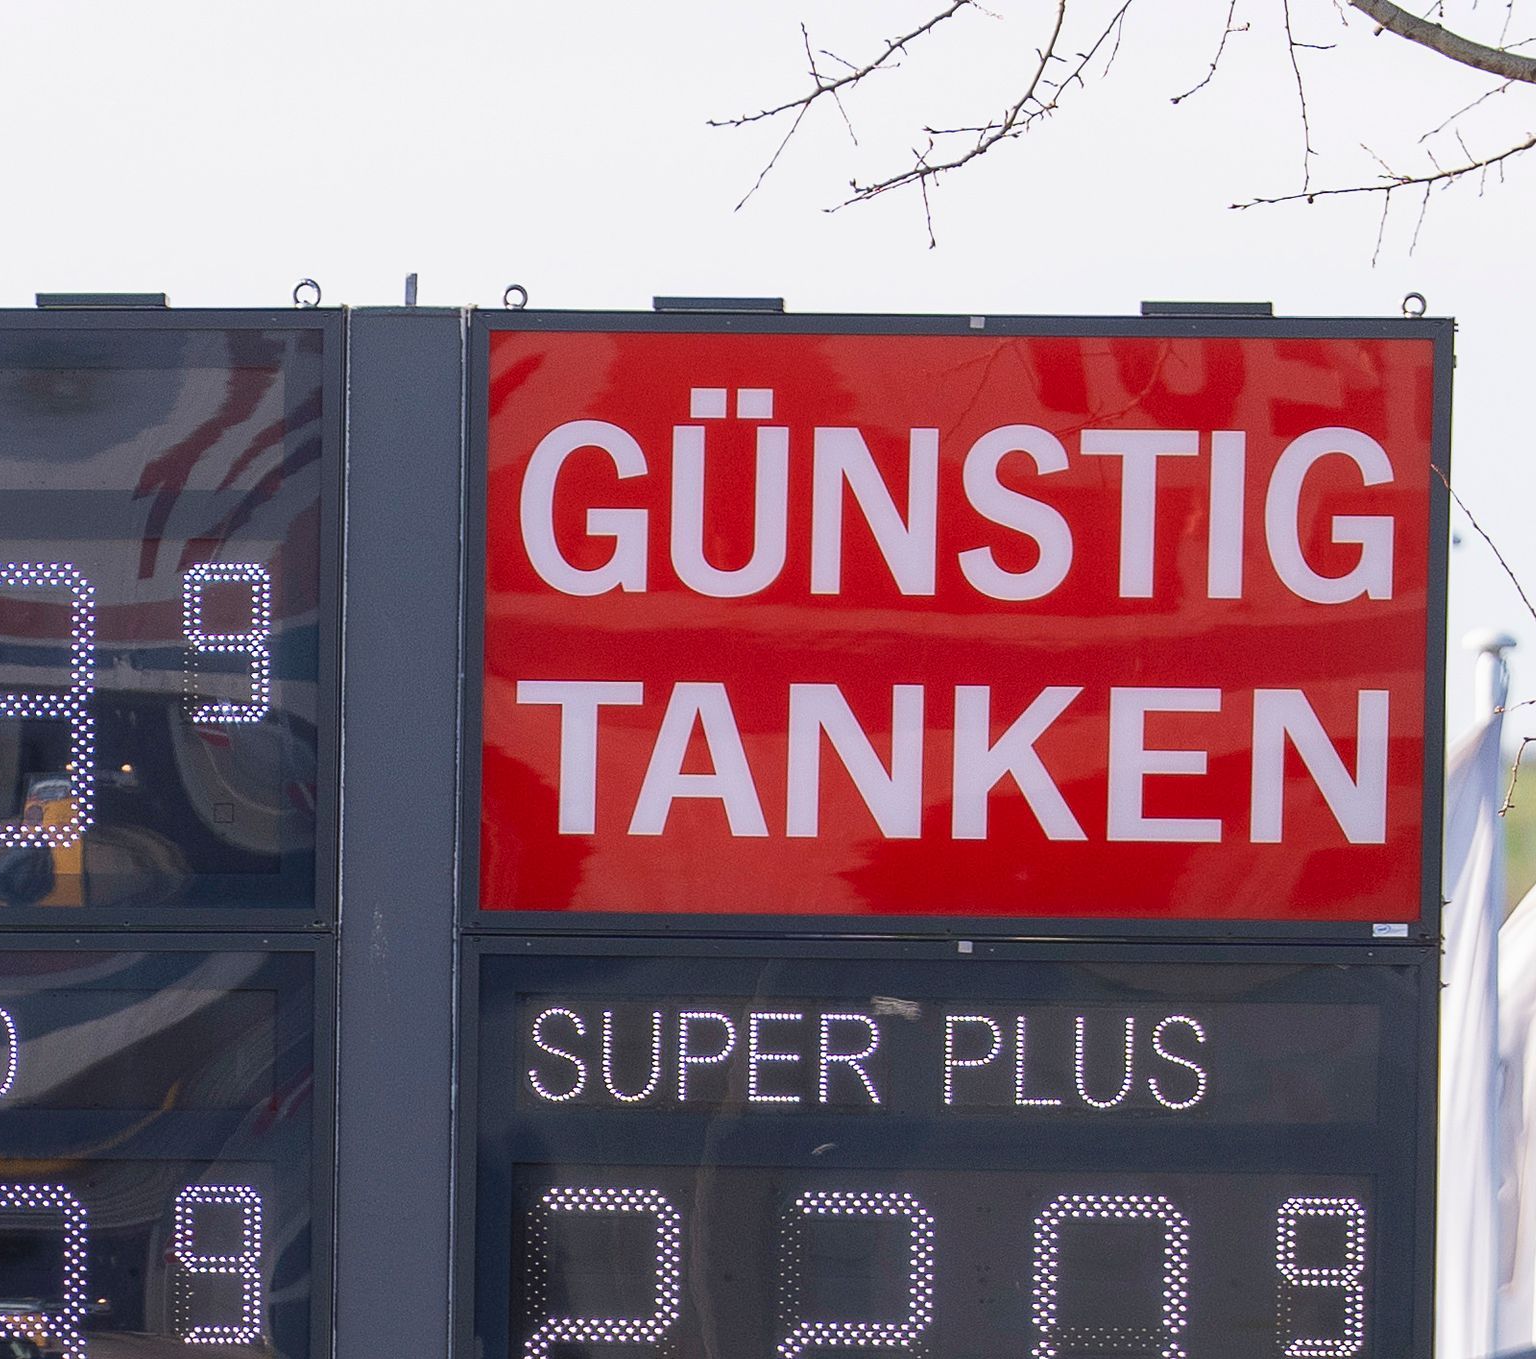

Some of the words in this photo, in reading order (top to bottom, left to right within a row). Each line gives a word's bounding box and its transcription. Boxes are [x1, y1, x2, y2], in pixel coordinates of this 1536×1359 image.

[519, 387, 1396, 605] GÜNSTIG
[515, 679, 1390, 845] TANKEN
[528, 1006, 881, 1104] SUPER
[943, 1013, 1206, 1110] PLUS
